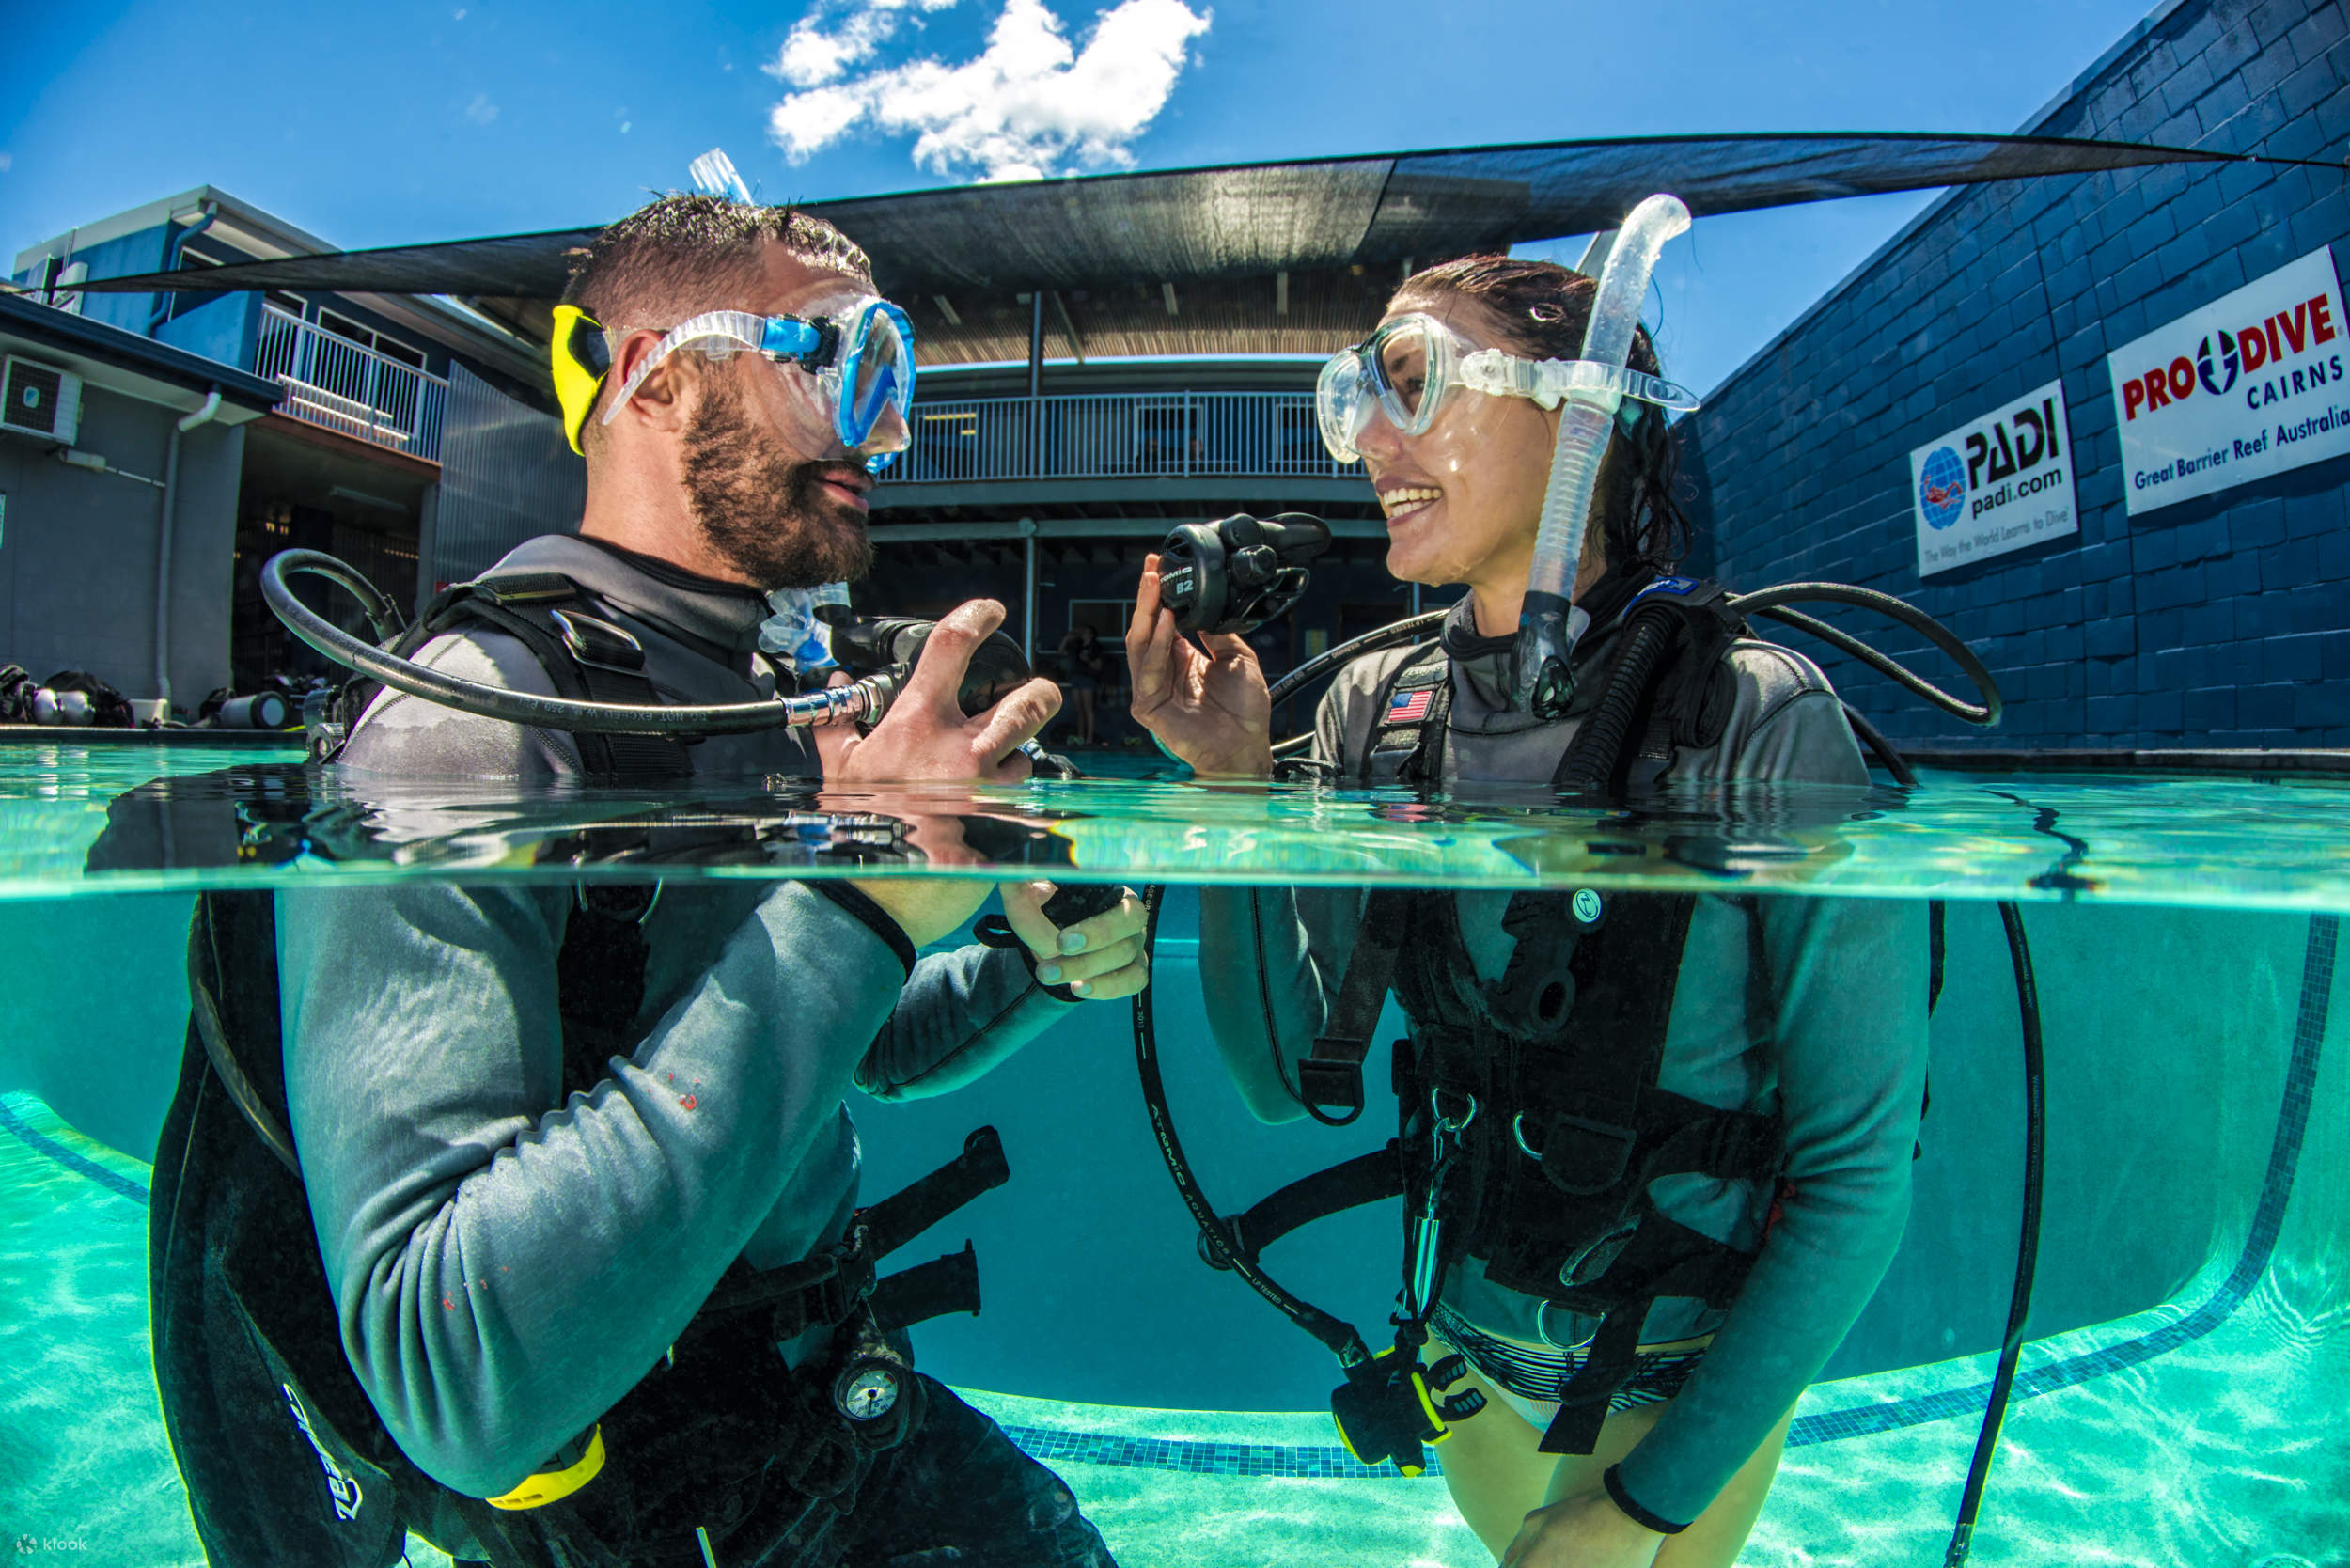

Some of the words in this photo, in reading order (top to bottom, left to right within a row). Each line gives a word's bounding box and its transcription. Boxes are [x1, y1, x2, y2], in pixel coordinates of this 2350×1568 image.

[2122, 355, 2196, 422] PRO
[2237, 292, 2336, 375] DIVE
[2247, 354, 2343, 410] CAIRNS
[1966, 397, 2060, 491] PADI
[2135, 463, 2174, 490] Great
[2176, 447, 2228, 478] Barrier
[2232, 429, 2269, 460] Reef
[2276, 405, 2350, 447] Australia
[1972, 468, 2062, 520] padi.com
[1924, 549, 1939, 562] The
[1940, 543, 1957, 558] Way
[1958, 539, 1972, 553] the
[1974, 526, 2000, 547] World
[2001, 519, 2031, 541] Learns
[2033, 516, 2044, 530] to
[2044, 509, 2068, 527] Dive
[1176, 580, 1194, 595] B2
